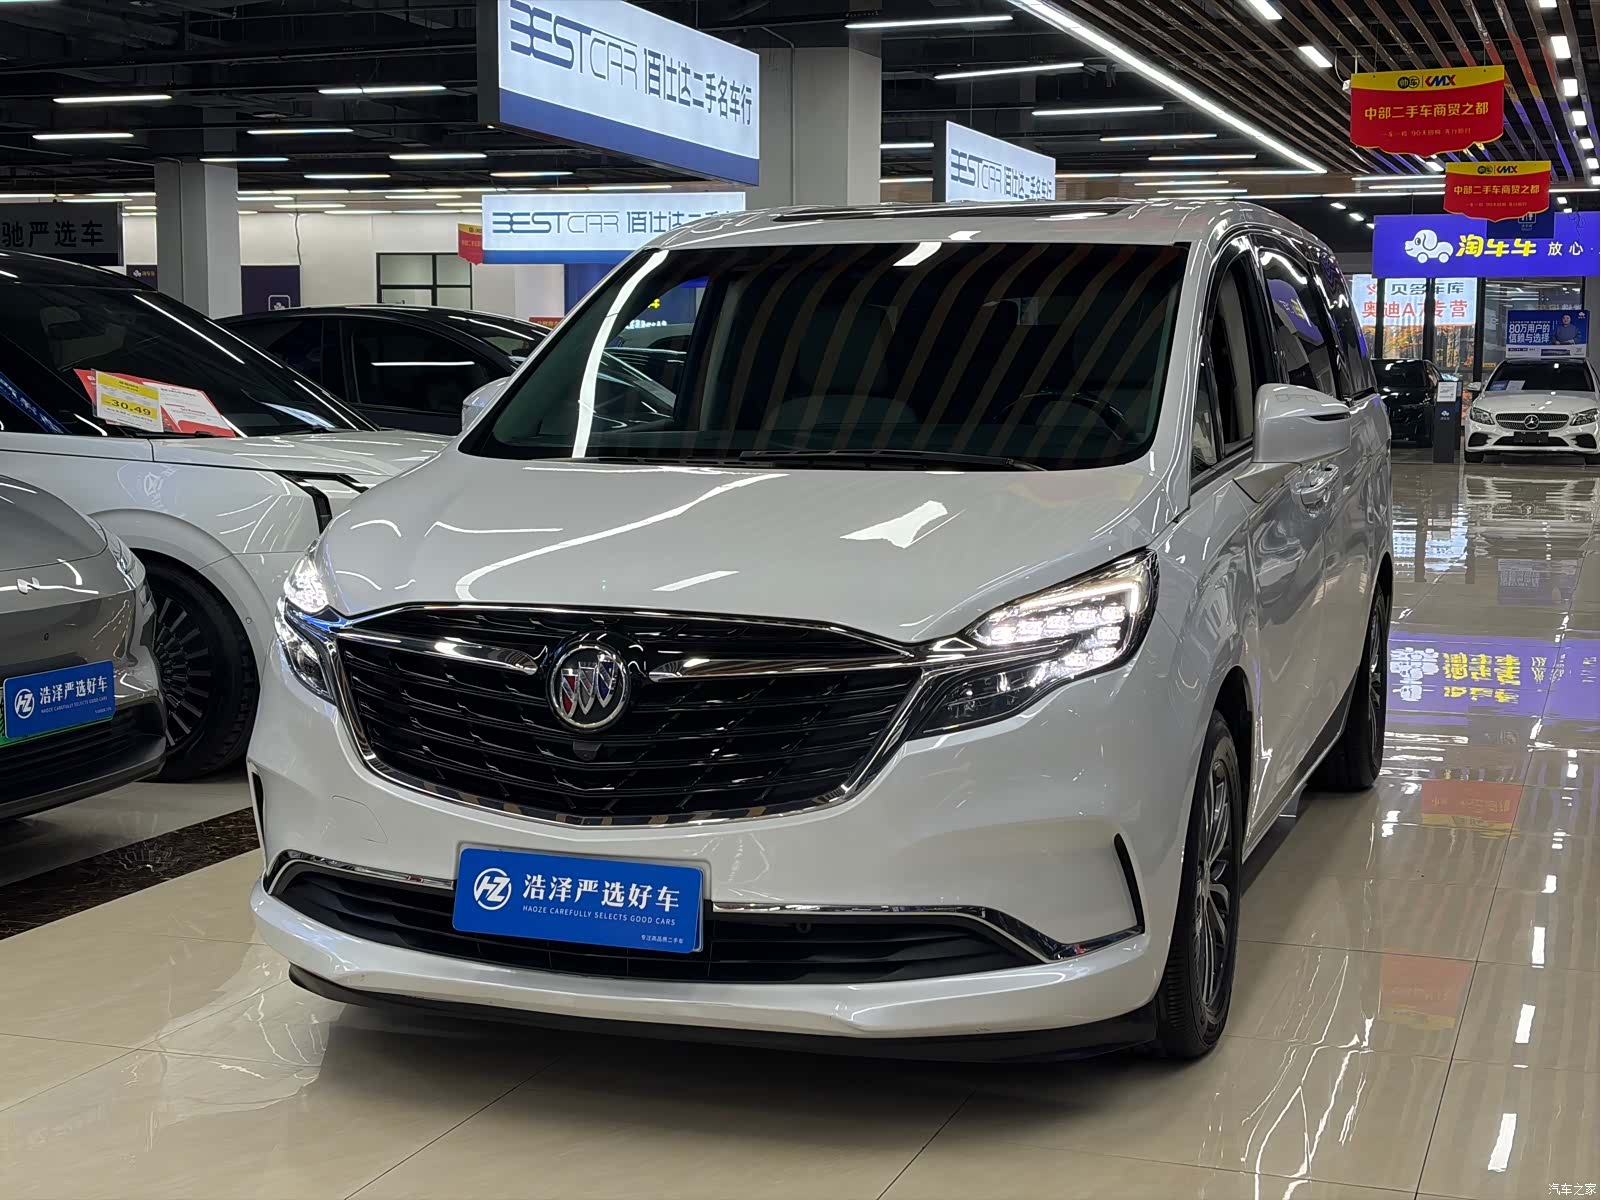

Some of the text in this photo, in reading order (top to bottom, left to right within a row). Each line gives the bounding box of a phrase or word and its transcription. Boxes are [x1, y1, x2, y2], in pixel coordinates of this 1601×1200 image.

[643, 47, 753, 126] 佰仕达二手名车行
[1364, 100, 1490, 121] 中部二手车商贸之都
[1453, 183, 1541, 196] 中部二手车商贸之都
[1508, 323, 1551, 334] 80万用户的
[1508, 333, 1550, 344] 信赖与选择
[111, 398, 152, 417] 30.49
[40, 675, 108, 704] 浩泽严选好车
[522, 873, 680, 913] 浩泽严选好车
[522, 905, 677, 926] HAOZE CAREFULLY SELECTS GOOD CARS
